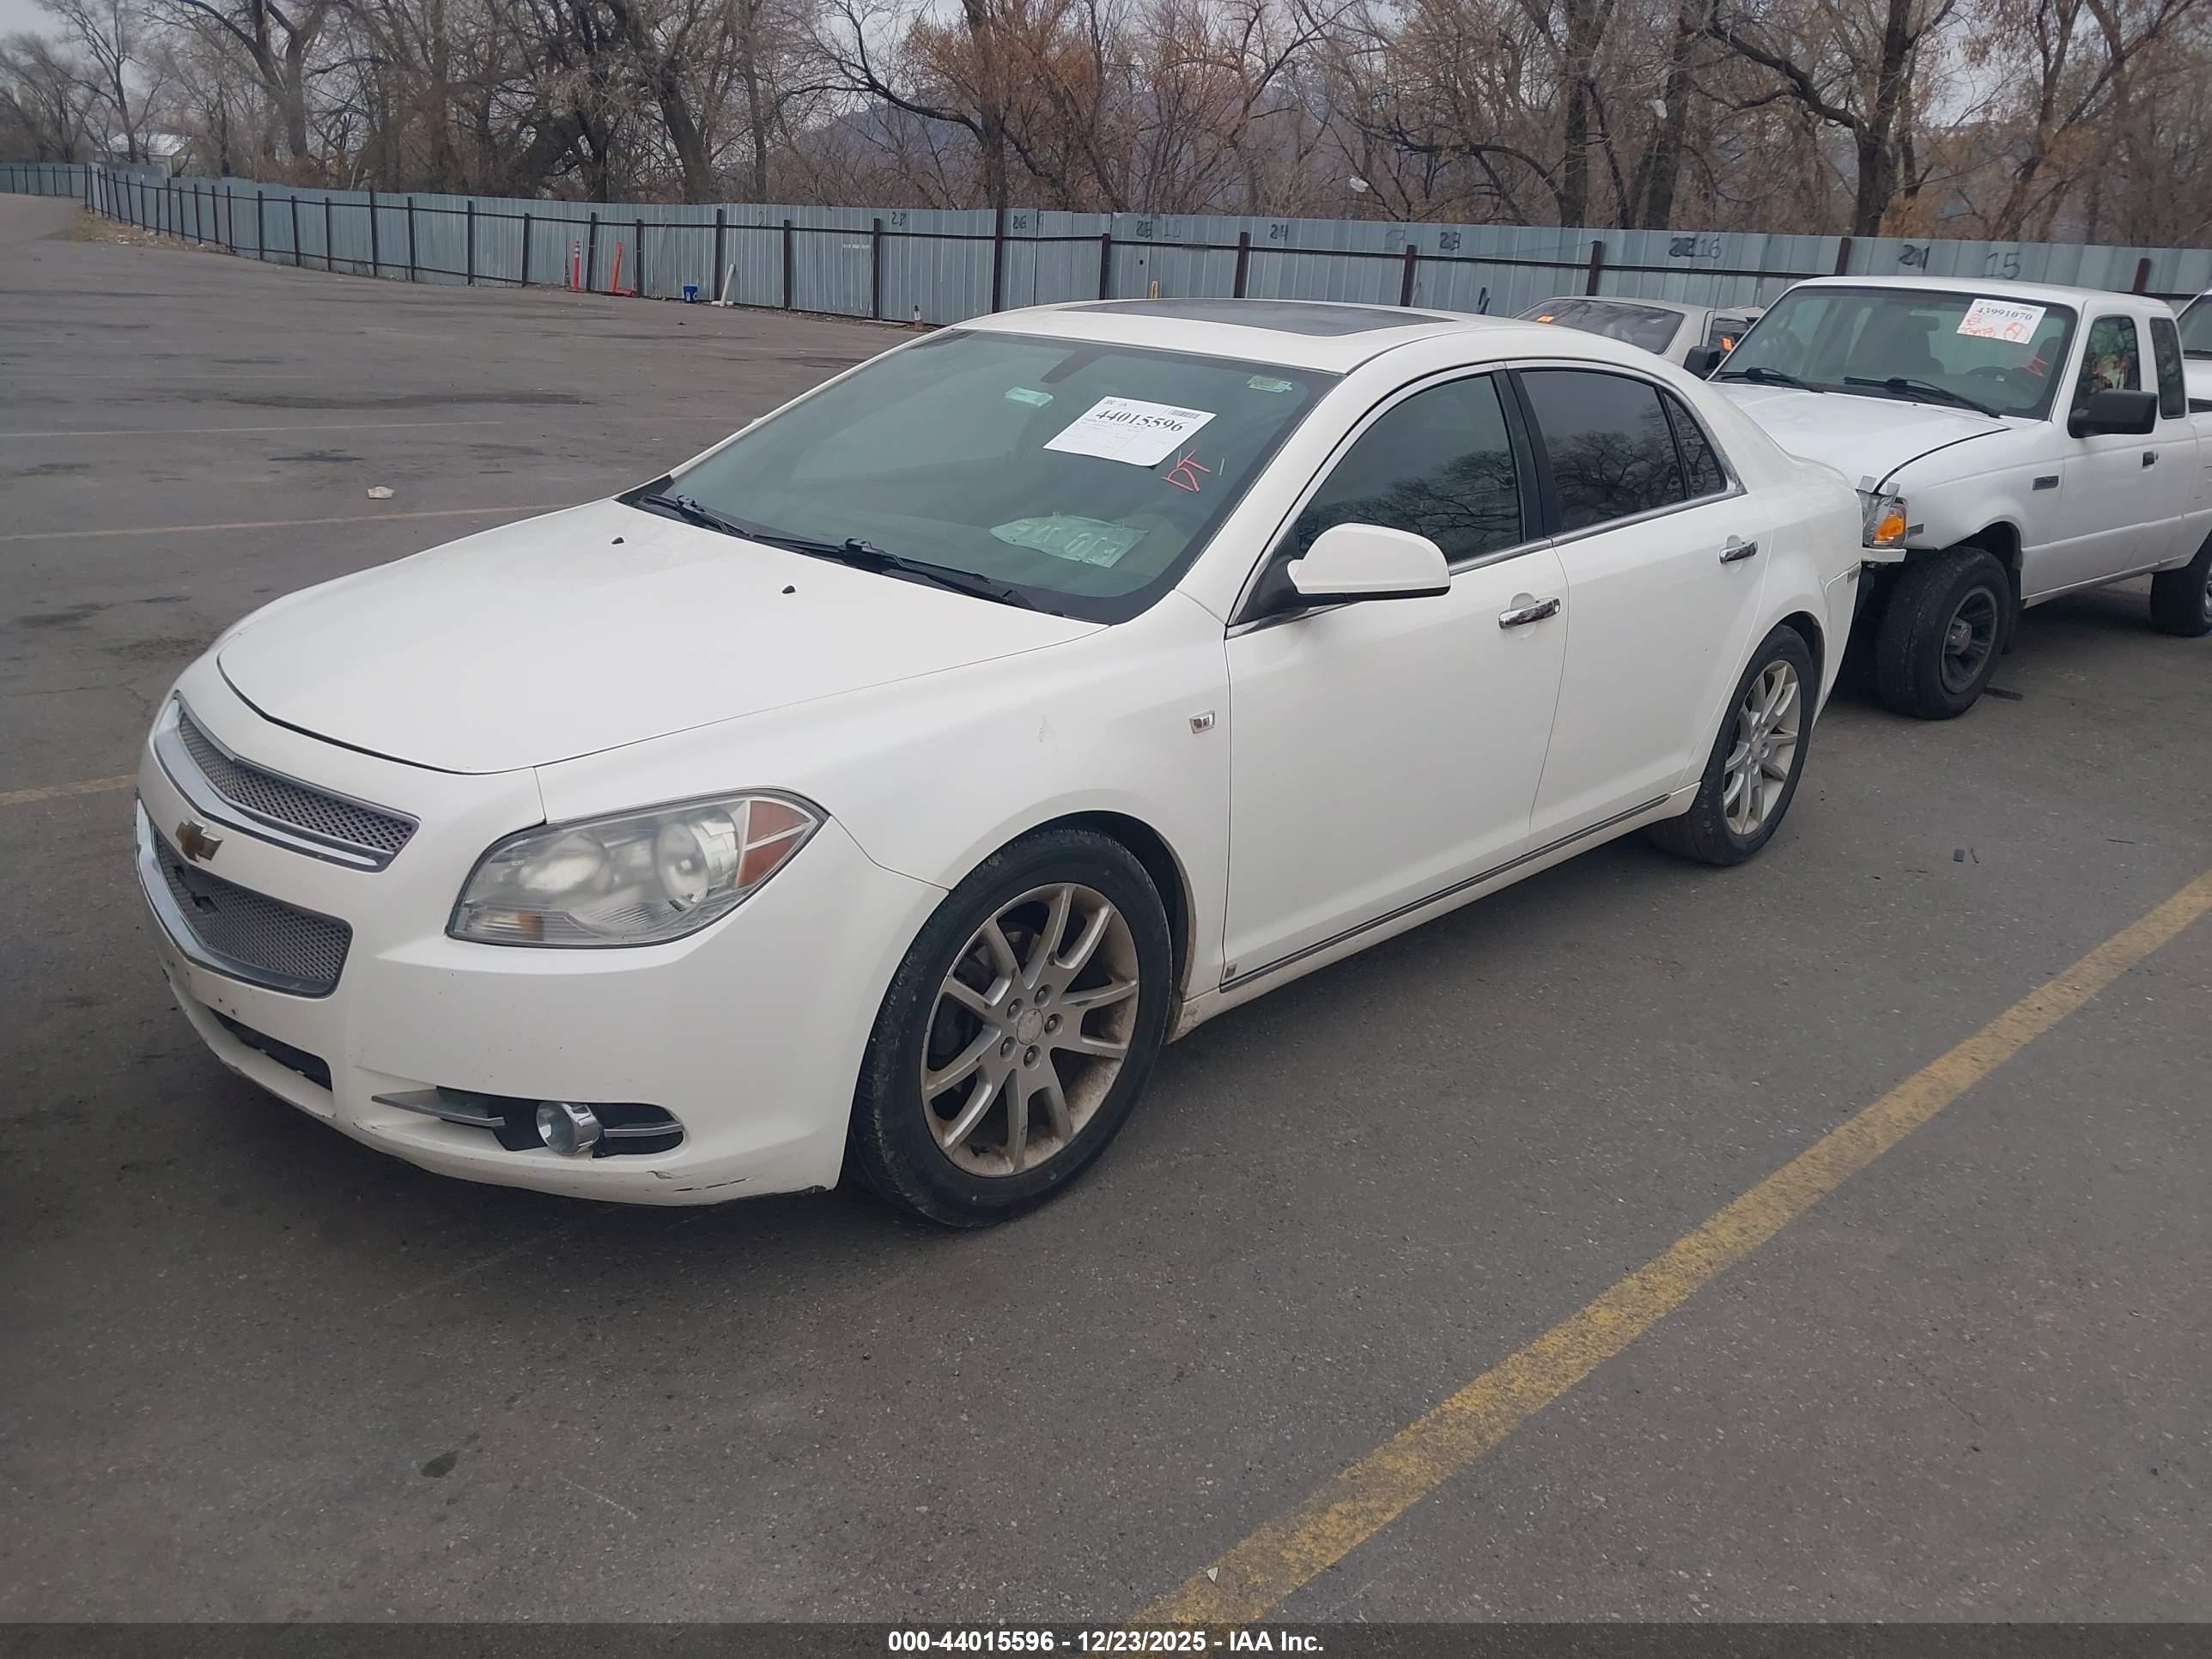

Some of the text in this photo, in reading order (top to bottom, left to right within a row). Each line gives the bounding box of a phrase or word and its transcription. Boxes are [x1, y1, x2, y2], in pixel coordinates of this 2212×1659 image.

[1270, 223, 1289, 241] 24
[1439, 232, 1461, 251] 23
[1983, 252, 2021, 280] 15
[1977, 307, 2033, 321] 43991070
[1096, 409, 1188, 433] 44015596
